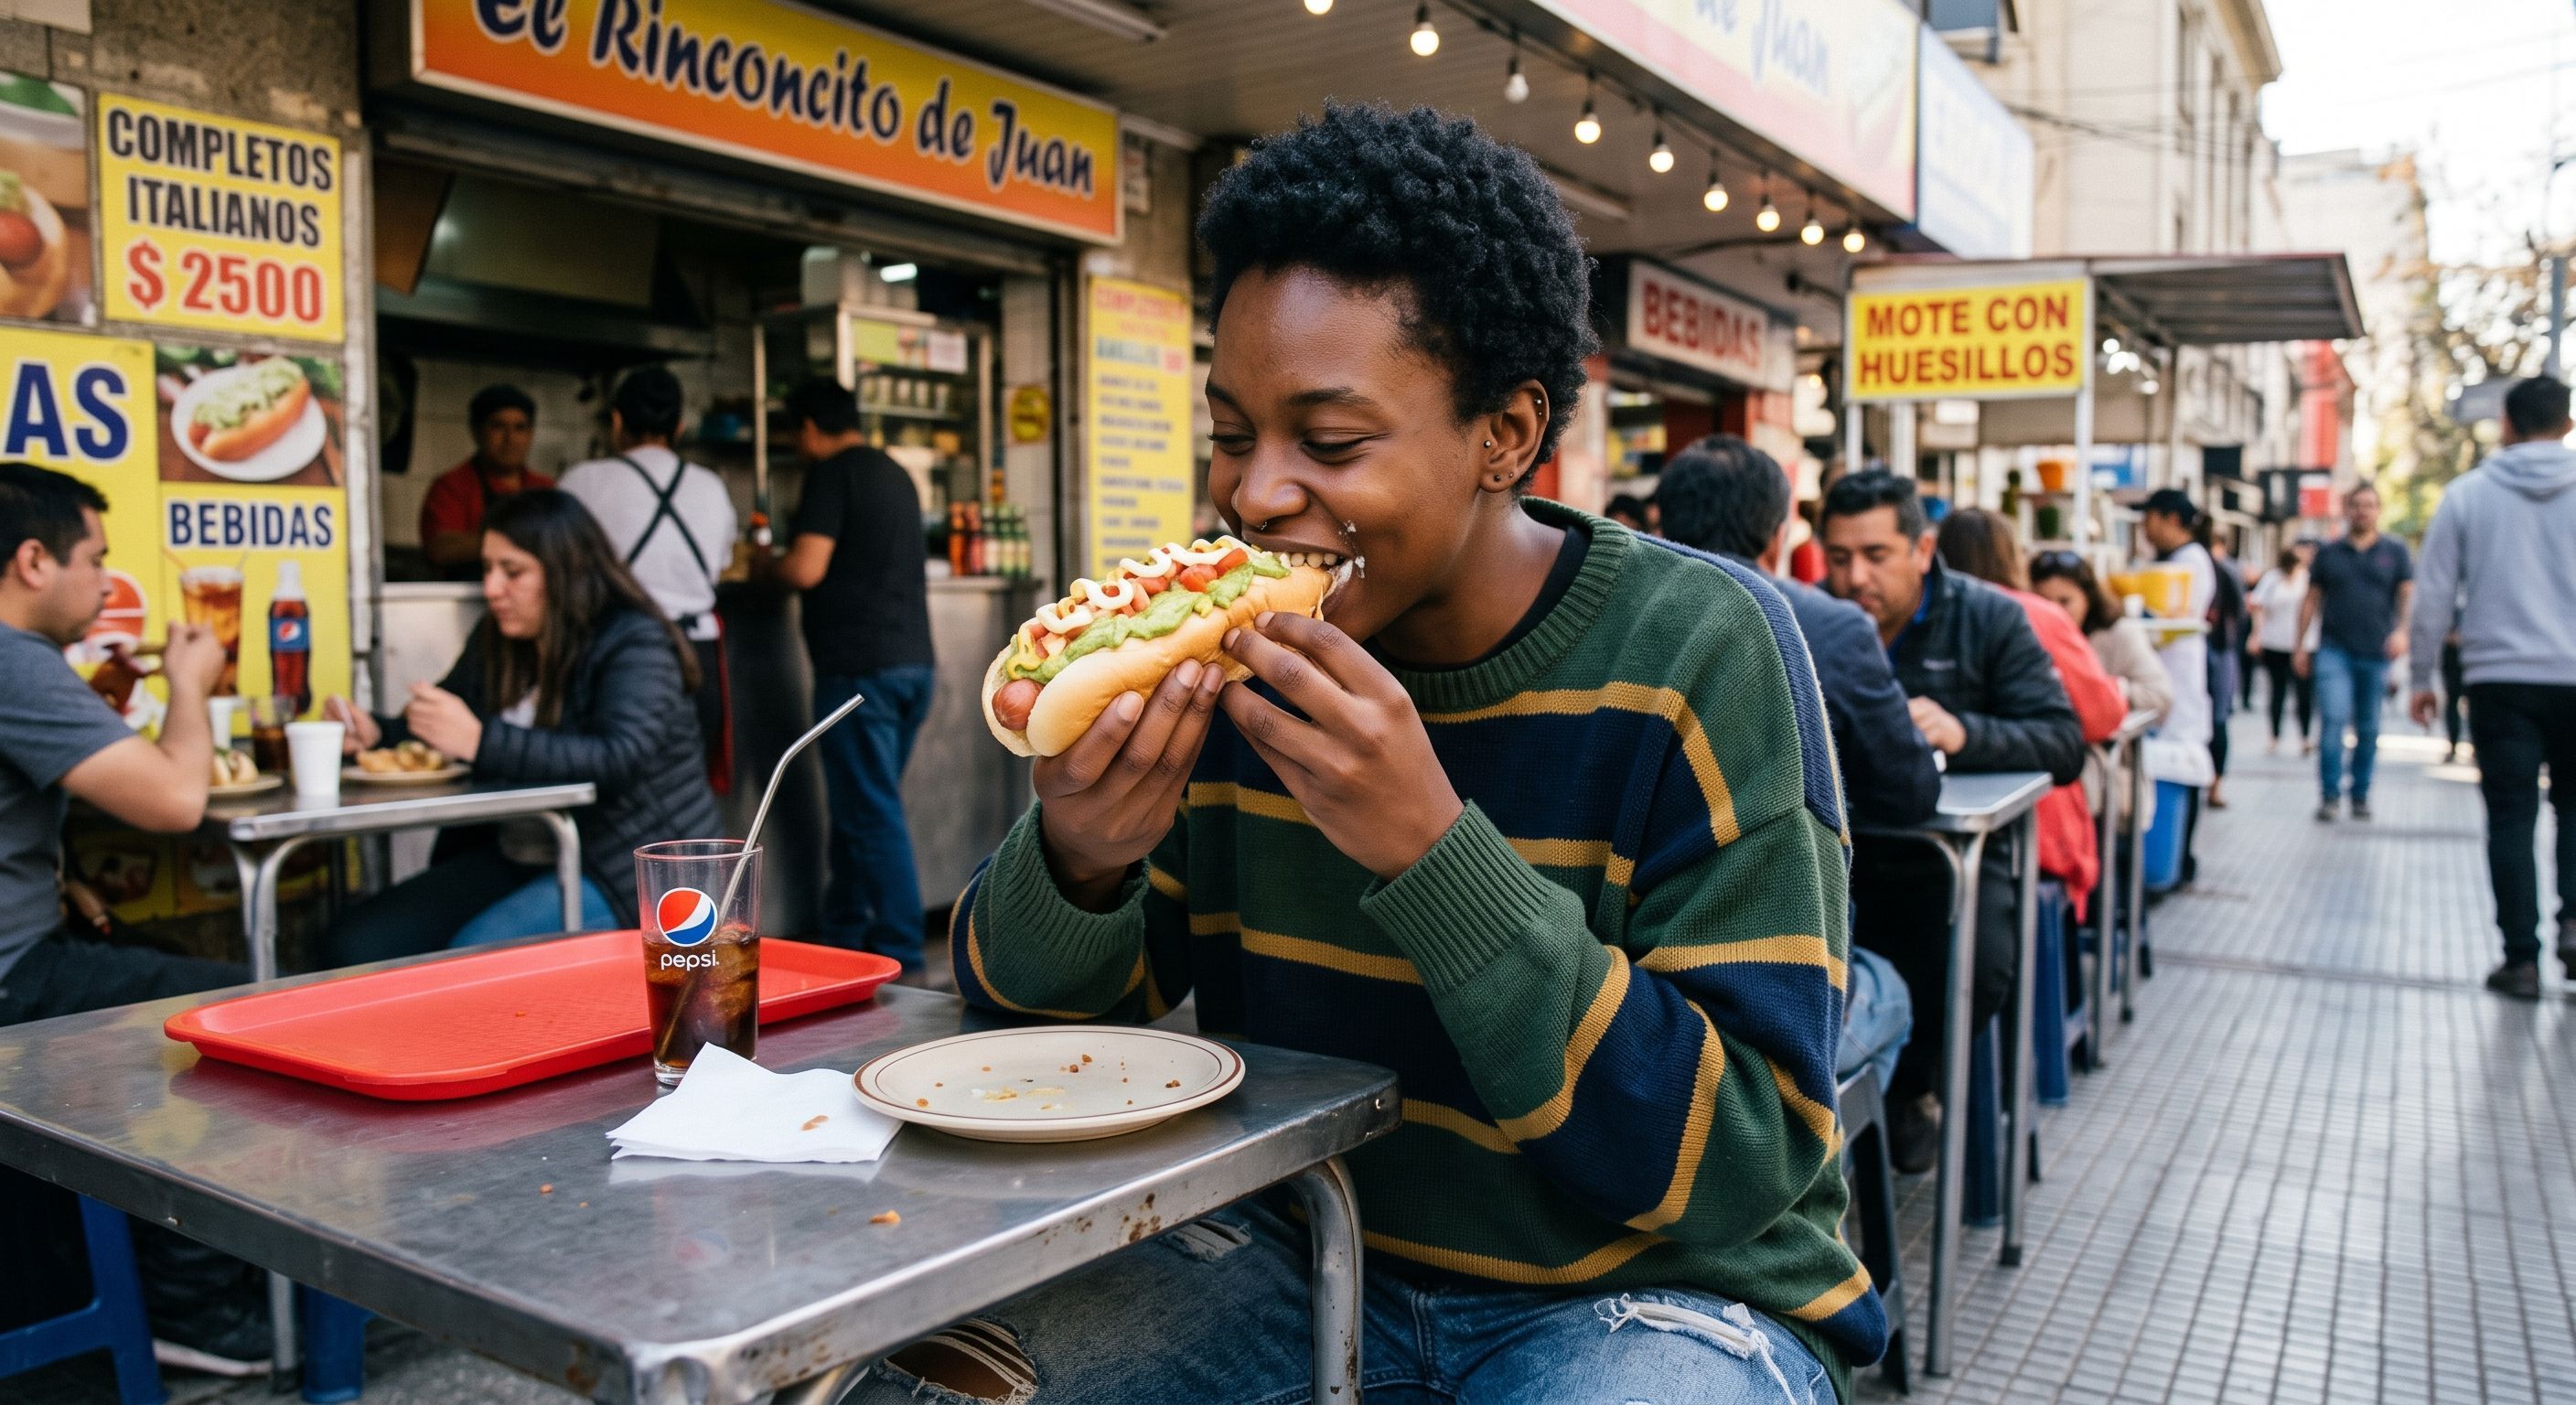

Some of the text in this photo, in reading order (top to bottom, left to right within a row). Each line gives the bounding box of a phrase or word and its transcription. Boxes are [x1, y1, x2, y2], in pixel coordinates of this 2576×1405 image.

[594, 0, 899, 138] Rinconcito
[918, 79, 973, 158] de
[990, 100, 1093, 193] Juan
[108, 109, 332, 191] COMPLETOS
[128, 177, 319, 247] ITALIANOS
[128, 241, 321, 323] $ 2500
[1867, 295, 2068, 337] MOTE CON
[1643, 282, 1759, 370] BEBIDAS
[1860, 343, 2074, 384] HUESILLOS
[5, 363, 130, 460] AS
[169, 501, 333, 548] BEBIDAS
